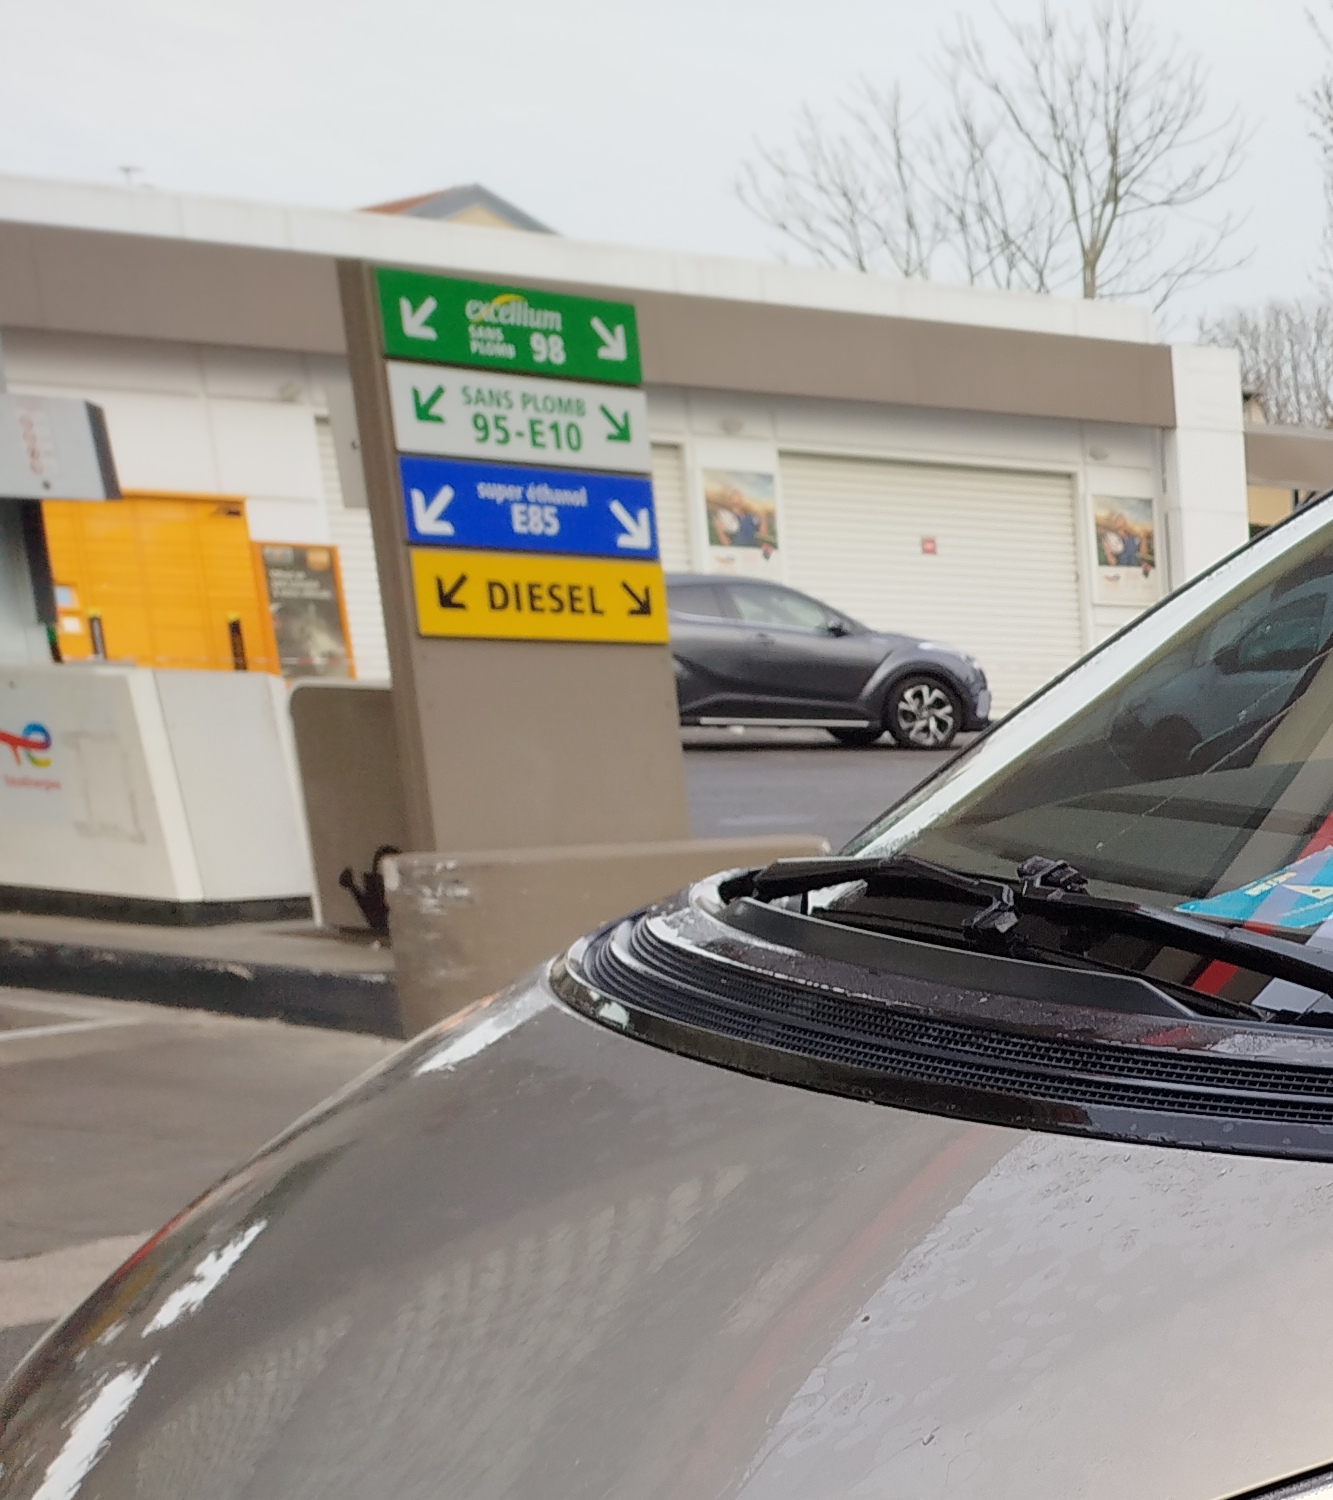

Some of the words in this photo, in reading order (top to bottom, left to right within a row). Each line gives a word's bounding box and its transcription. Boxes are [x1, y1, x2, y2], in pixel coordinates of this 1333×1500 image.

[465, 297, 562, 332] excellium
[468, 324, 504, 342] SANS
[530, 332, 566, 364] 98
[461, 385, 513, 409] SANS
[521, 392, 585, 417] PLOMB
[473, 412, 582, 452] 95-E10
[476, 481, 523, 504] super
[511, 503, 560, 536] E85
[487, 579, 604, 616] DIESEL
